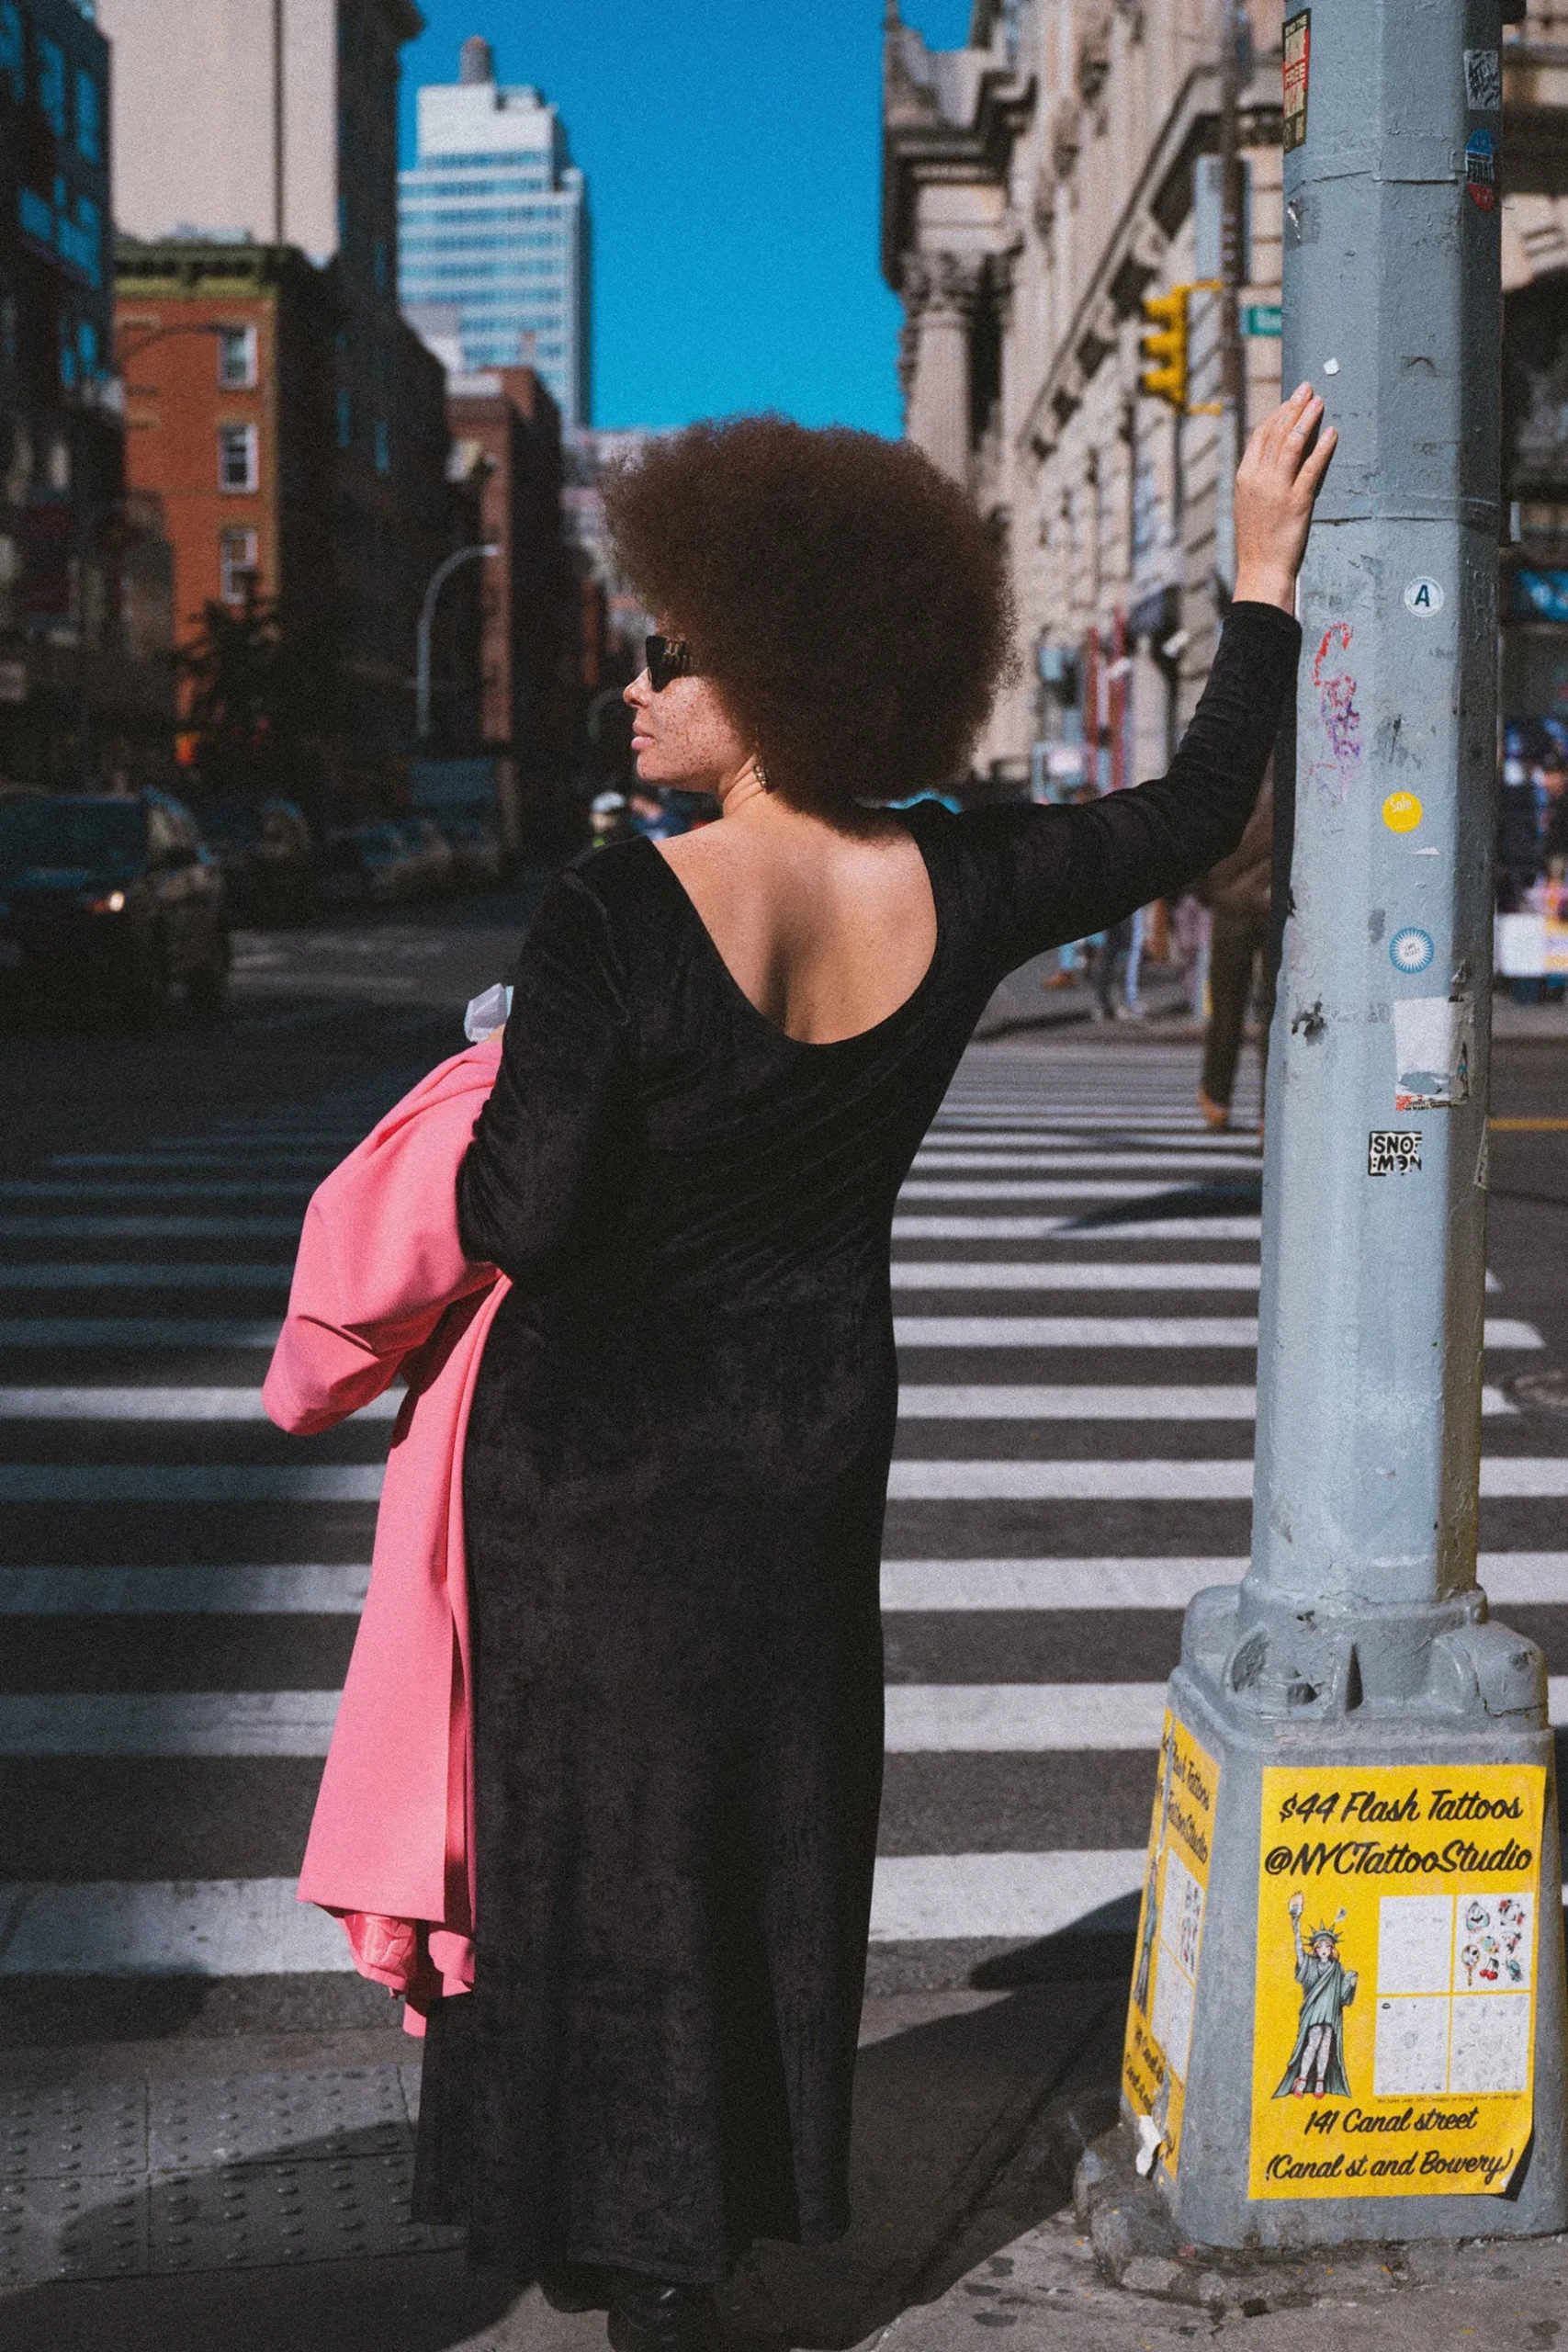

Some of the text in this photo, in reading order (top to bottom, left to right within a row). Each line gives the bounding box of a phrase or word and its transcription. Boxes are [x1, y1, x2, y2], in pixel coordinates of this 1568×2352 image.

[1415, 584, 1429, 607] A
[1279, 1788, 1524, 1824] $44 Flash Tattoos
[1264, 1838, 1533, 1876] @NYCTattooStudio
[1303, 2106, 1479, 2135] 141 Canal street
[1265, 2147, 1515, 2186] (Canal st and Bowery)
